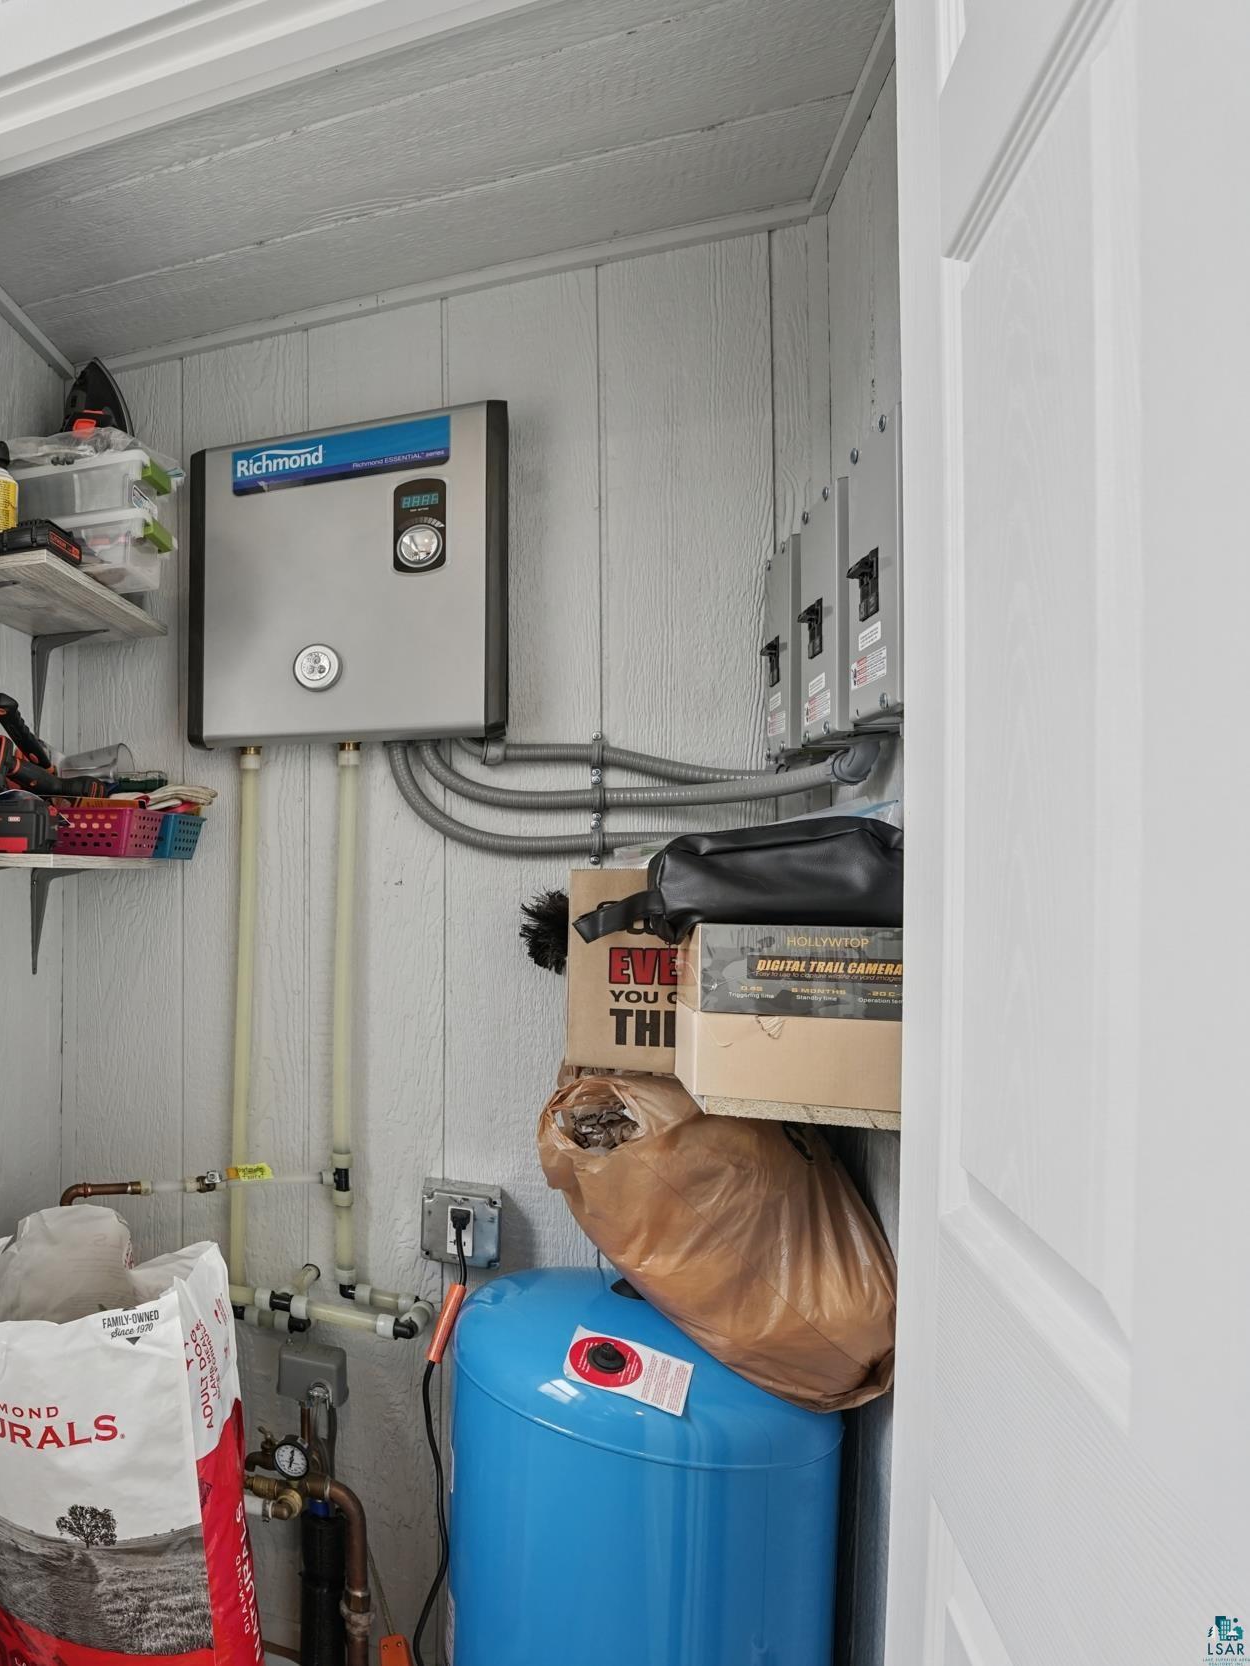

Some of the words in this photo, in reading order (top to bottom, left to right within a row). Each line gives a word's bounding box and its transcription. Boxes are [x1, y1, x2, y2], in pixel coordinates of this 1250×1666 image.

[236, 445, 323, 478] Richmond
[352, 459, 383, 469] Richmond
[787, 936, 869, 948] HOLLYWTOP
[756, 959, 806, 972] DIGITAL
[809, 961, 845, 974] TRAIL
[847, 962, 903, 976] CAMERA
[610, 990, 658, 1004] YOU
[729, 991, 760, 1000] Triggering
[796, 994, 823, 1002] Standby
[102, 1310, 160, 1329] FAMILY-OWNED
[111, 1327, 135, 1339] Since
[136, 1322, 154, 1334] 1970
[190, 1329, 207, 1371] DOG
[200, 1376, 214, 1429] ADULT
[236, 1501, 262, 1663] NATURALS
[236, 1555, 250, 1634] DIAMOND
